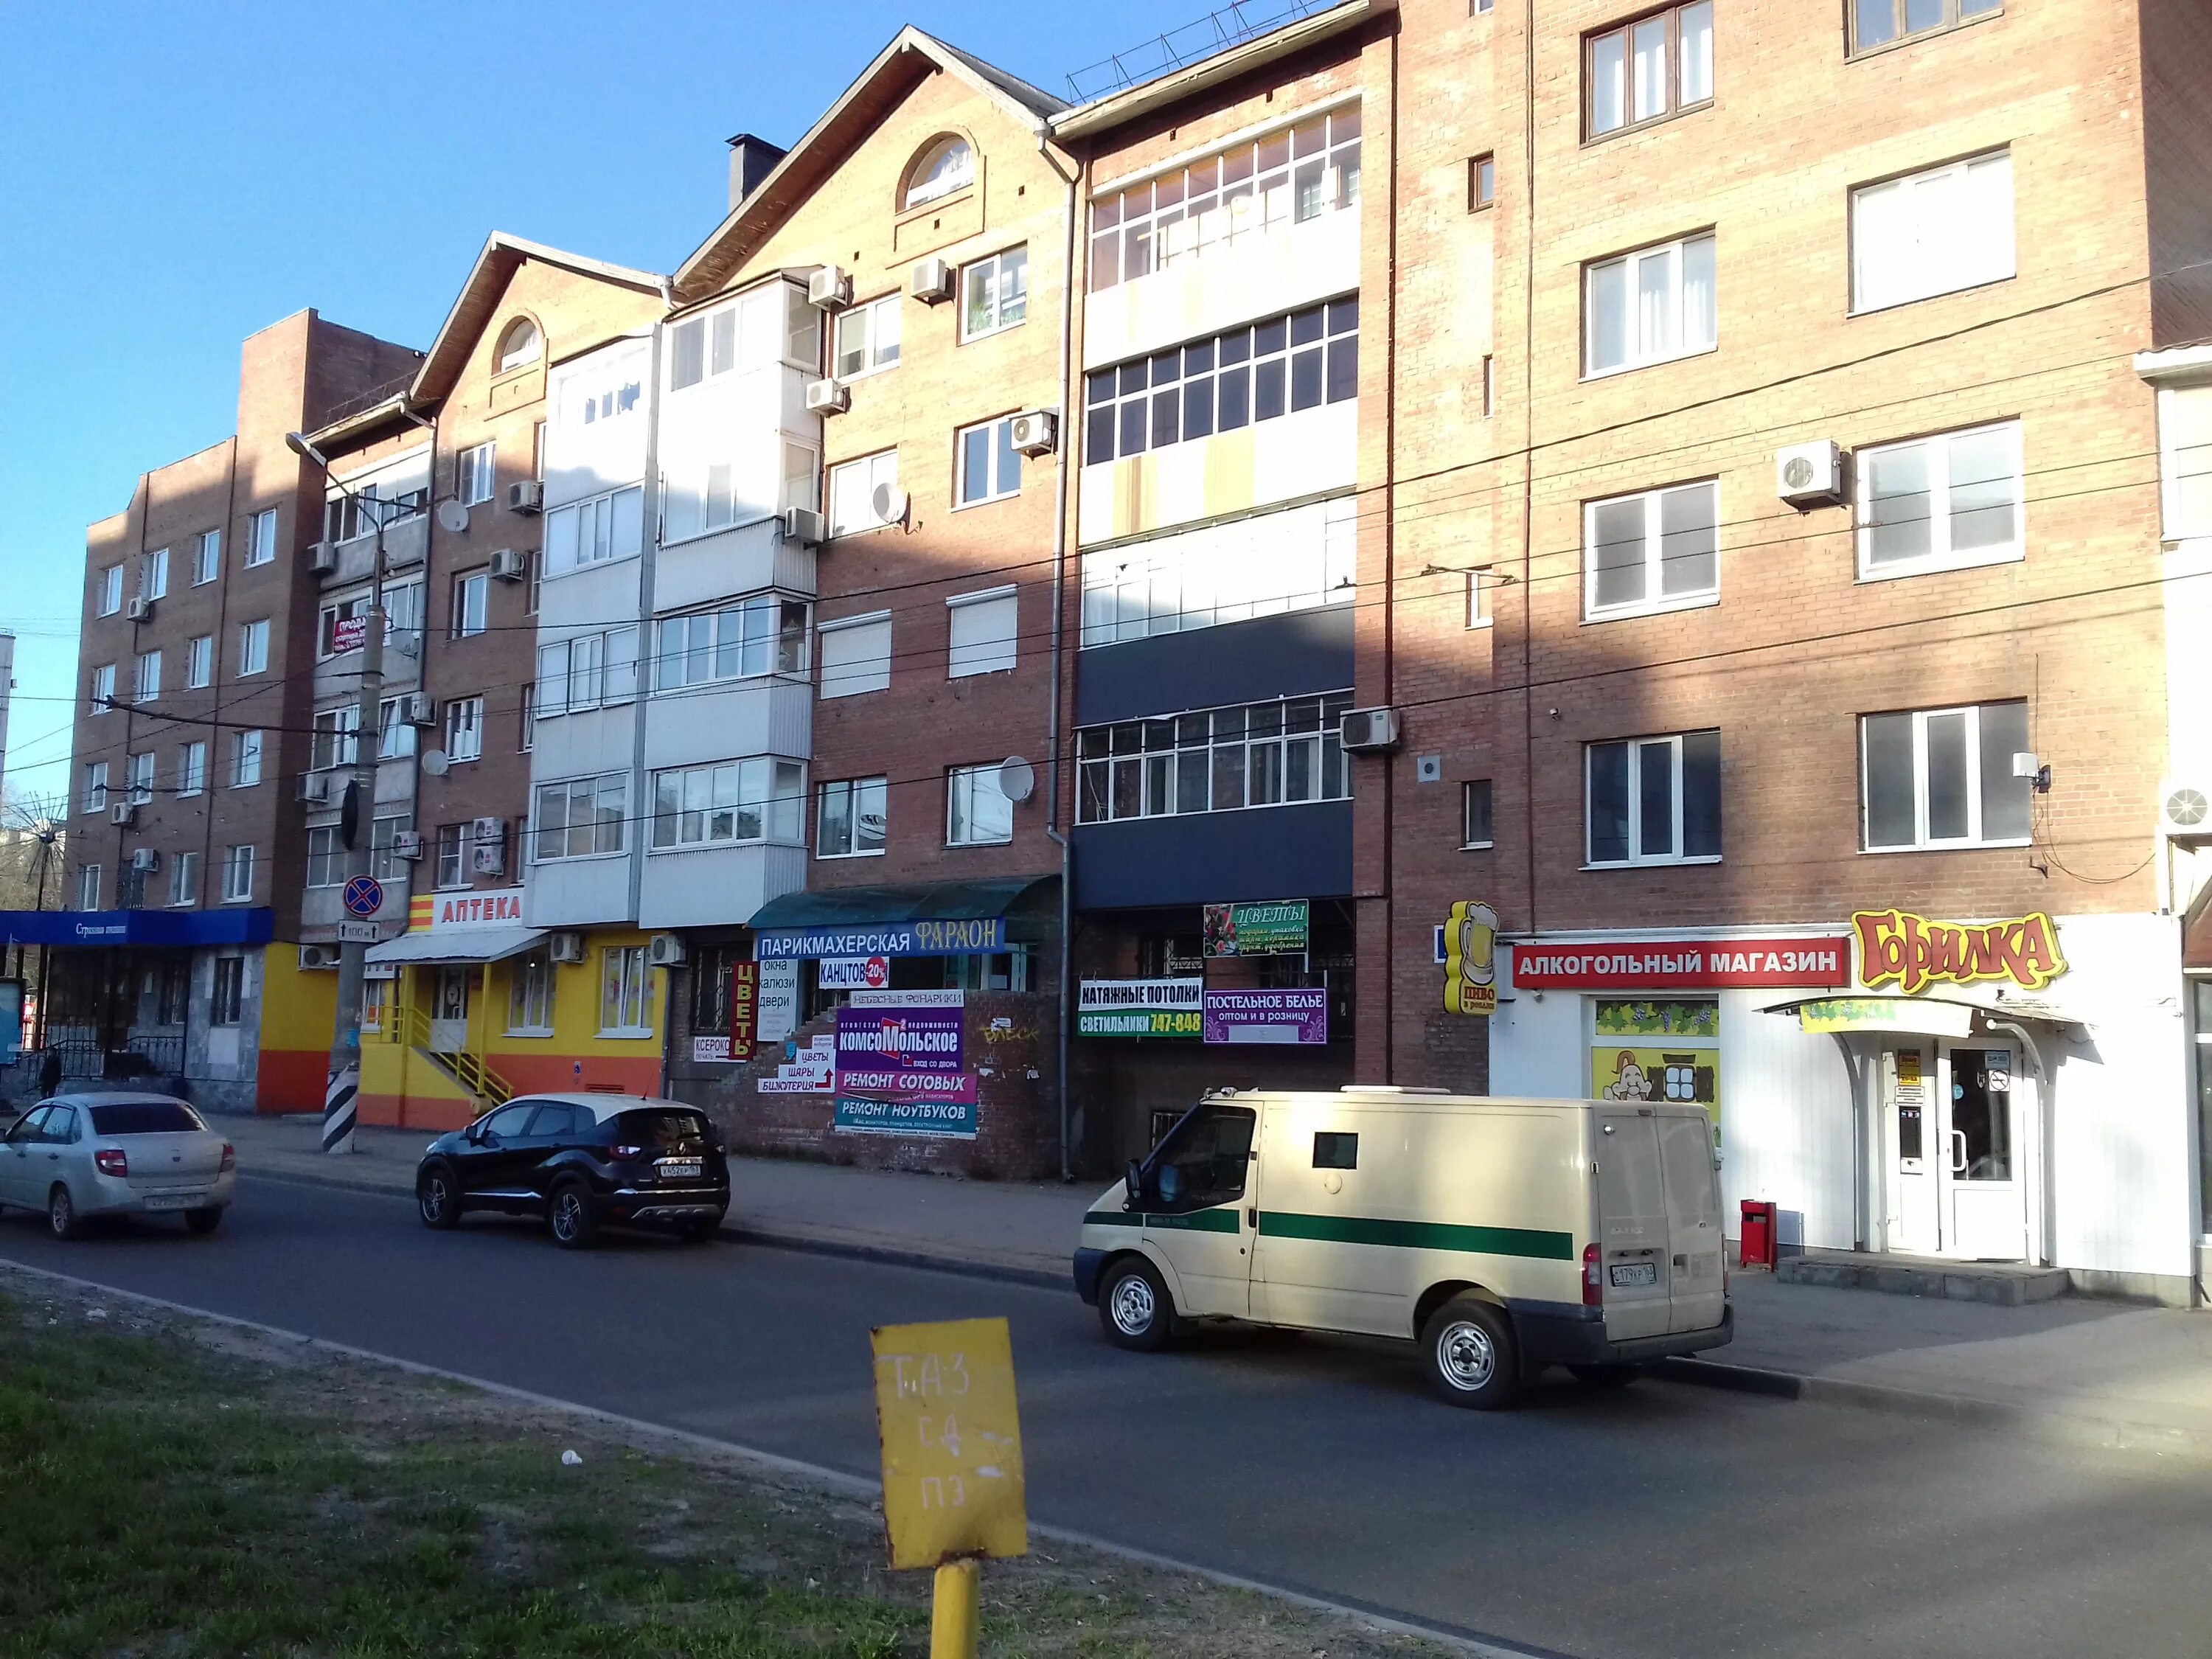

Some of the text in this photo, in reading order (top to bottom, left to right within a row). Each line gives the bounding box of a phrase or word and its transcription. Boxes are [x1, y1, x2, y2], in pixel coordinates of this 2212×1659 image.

[442, 897, 520, 923] АПТЕКА
[1238, 905, 1305, 927] ЦВЕТЫ
[762, 919, 997, 956] ПАРИКМАХЕРСКАЯ ФАРАОН
[764, 960, 787, 971] окна
[1518, 949, 1836, 975] АЛКОГОЛЬНЫЙ МАГАЗИН
[854, 995, 961, 1004] НЕБЕСНЫЕ ФОНАРИКИ
[1082, 984, 1200, 1004] НАТЯЖНЫЕ ПОТОЛКИ
[1464, 986, 1495, 1001] ПИВО
[734, 964, 754, 1055] ЦВЕТЫ
[759, 996, 790, 1009] двери
[1207, 995, 1323, 1009] ПОСТЕЛЬНОЕ БЕЛЬЕ
[1080, 1013, 1201, 1032] СВЕТИЛЬНИКИ 747-848
[1219, 1012, 1310, 1023] оптом и в розницу
[802, 1052, 829, 1063] ЦВЕТЫ
[788, 1068, 815, 1077] ШАРЫ
[762, 1081, 814, 1091] БИЖУТЕРИЯ
[843, 1073, 967, 1091] РЕМОНТ СОТОВЫХ
[842, 1102, 967, 1119] РЕМОНТ НОУТБУКОВ
